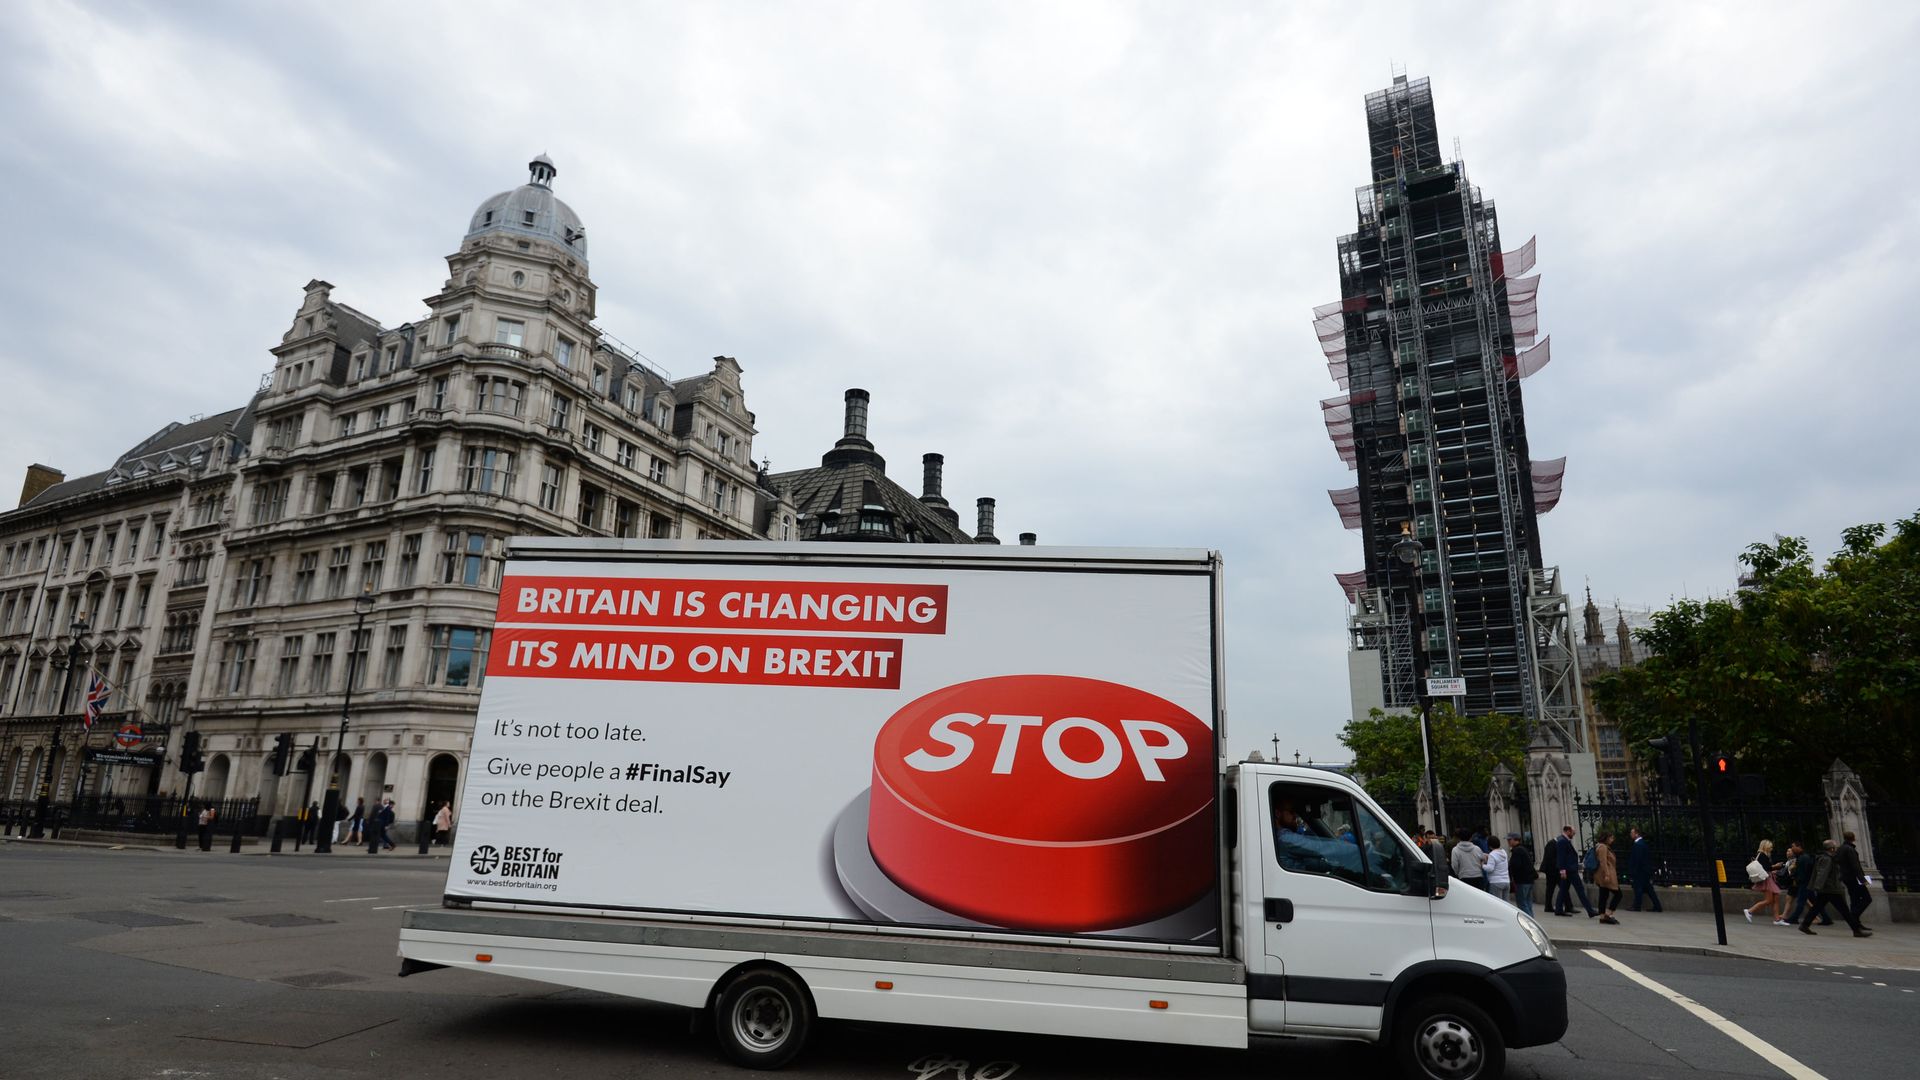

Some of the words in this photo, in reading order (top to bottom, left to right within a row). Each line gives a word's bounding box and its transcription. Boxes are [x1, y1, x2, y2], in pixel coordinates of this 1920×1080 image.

[516, 587, 661, 617] BRITAIN
[672, 590, 706, 617] IS
[718, 592, 939, 624] CHANGING
[506, 640, 559, 669] ITS
[569, 642, 675, 671] MIND
[687, 645, 750, 674] ON
[762, 648, 895, 679] BREXIT
[493, 719, 522, 737] It’s
[527, 721, 561, 738] not
[566, 722, 599, 740] too
[604, 722, 647, 742] late.
[903, 712, 1189, 782] STOP
[487, 757, 532, 776] Give
[536, 761, 605, 782] people
[609, 766, 621, 780] a
[625, 762, 731, 788] #FinalSay
[481, 791, 506, 806] on
[511, 789, 544, 808] the
[549, 790, 611, 811] Brexit
[615, 793, 663, 814] deal.
[503, 846, 541, 862] BEST
[542, 848, 564, 864] for
[501, 862, 560, 880] BRITAIN
[467, 879, 558, 892] www.bestforbritain.org
